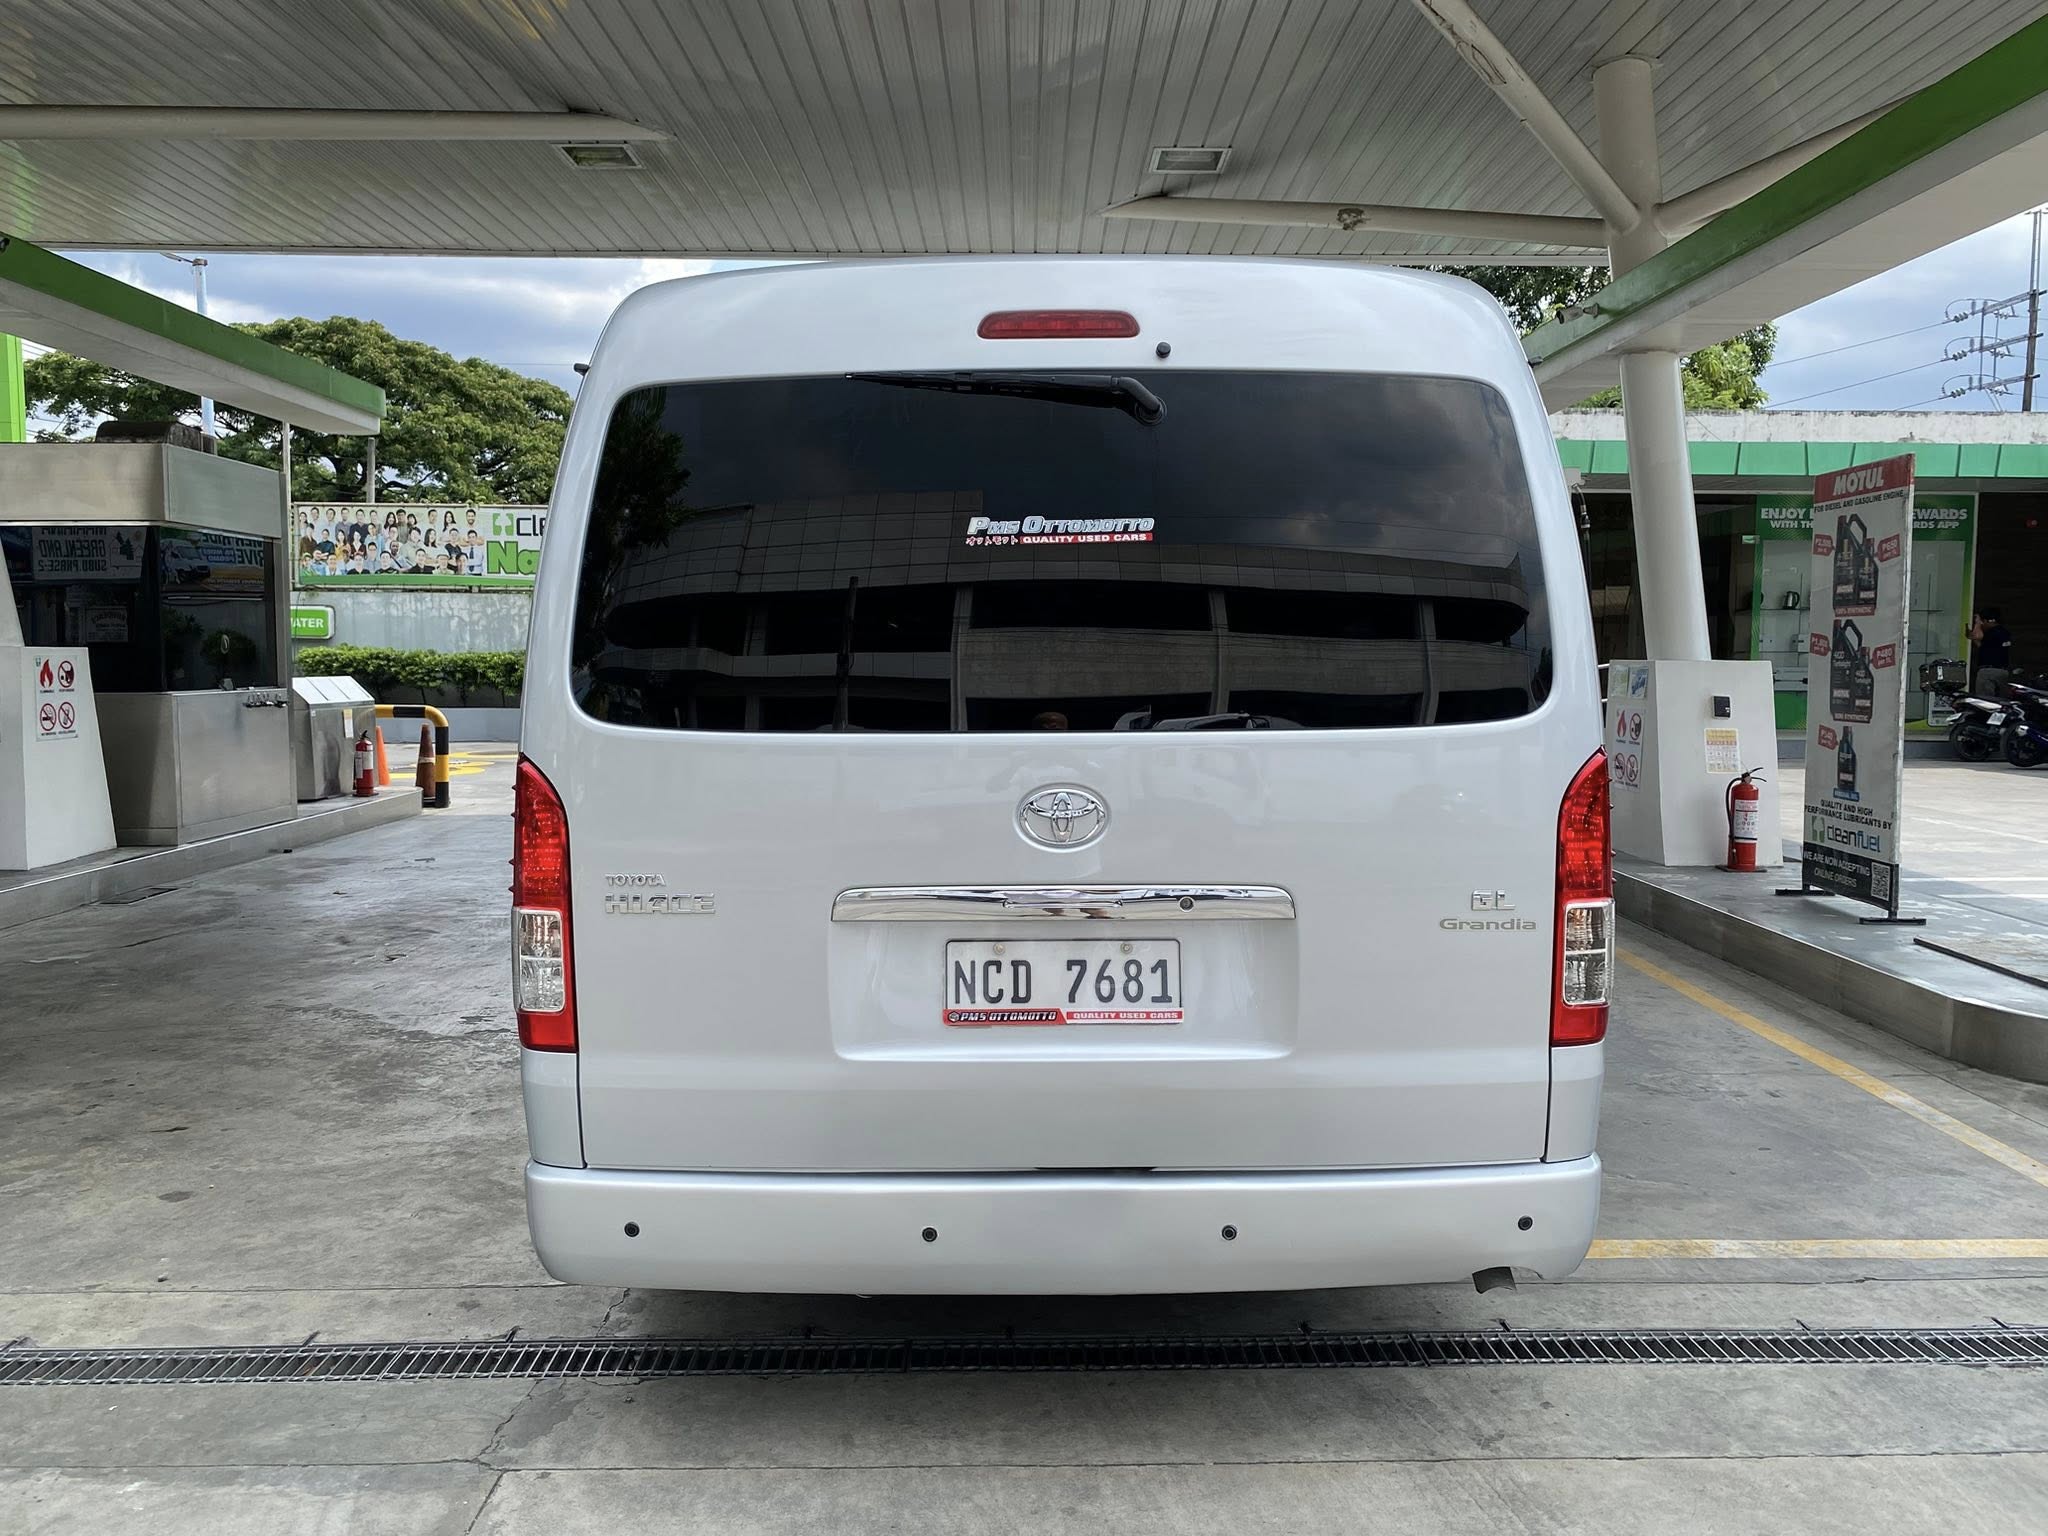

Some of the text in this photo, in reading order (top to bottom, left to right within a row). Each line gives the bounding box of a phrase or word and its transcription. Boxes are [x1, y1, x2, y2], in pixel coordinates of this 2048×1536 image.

[1833, 466, 1884, 496] MOTUL
[1814, 505, 1824, 513] FOR
[1825, 502, 1842, 511] DIESEL
[1843, 499, 1853, 507] AND
[1855, 494, 1882, 506] GASOLINE
[1761, 507, 1806, 519] ENJOY
[1770, 520, 1798, 529] WITH
[1912, 521, 1960, 529] RDS APP
[1022, 533, 1147, 544] QUALITY USED CARS
[290, 618, 324, 628] ATER
[1821, 799, 1873, 816] QUALITY AND HIGH
[1804, 805, 1892, 830] PERFORMANCE LUBRICANTS BY
[1827, 824, 1881, 853] cleanfuel
[1839, 859, 1871, 877] ACCEPTING
[605, 873, 667, 887] TOYOTA
[605, 893, 715, 914] HIACE
[1471, 889, 1516, 911] GL
[1439, 918, 1537, 930] Grandia
[954, 959, 1173, 1004] NCD 7681
[960, 1011, 1057, 1022] PMS OTTOMOTTO
[1073, 1011, 1179, 1020] QUALITY USED CARS
